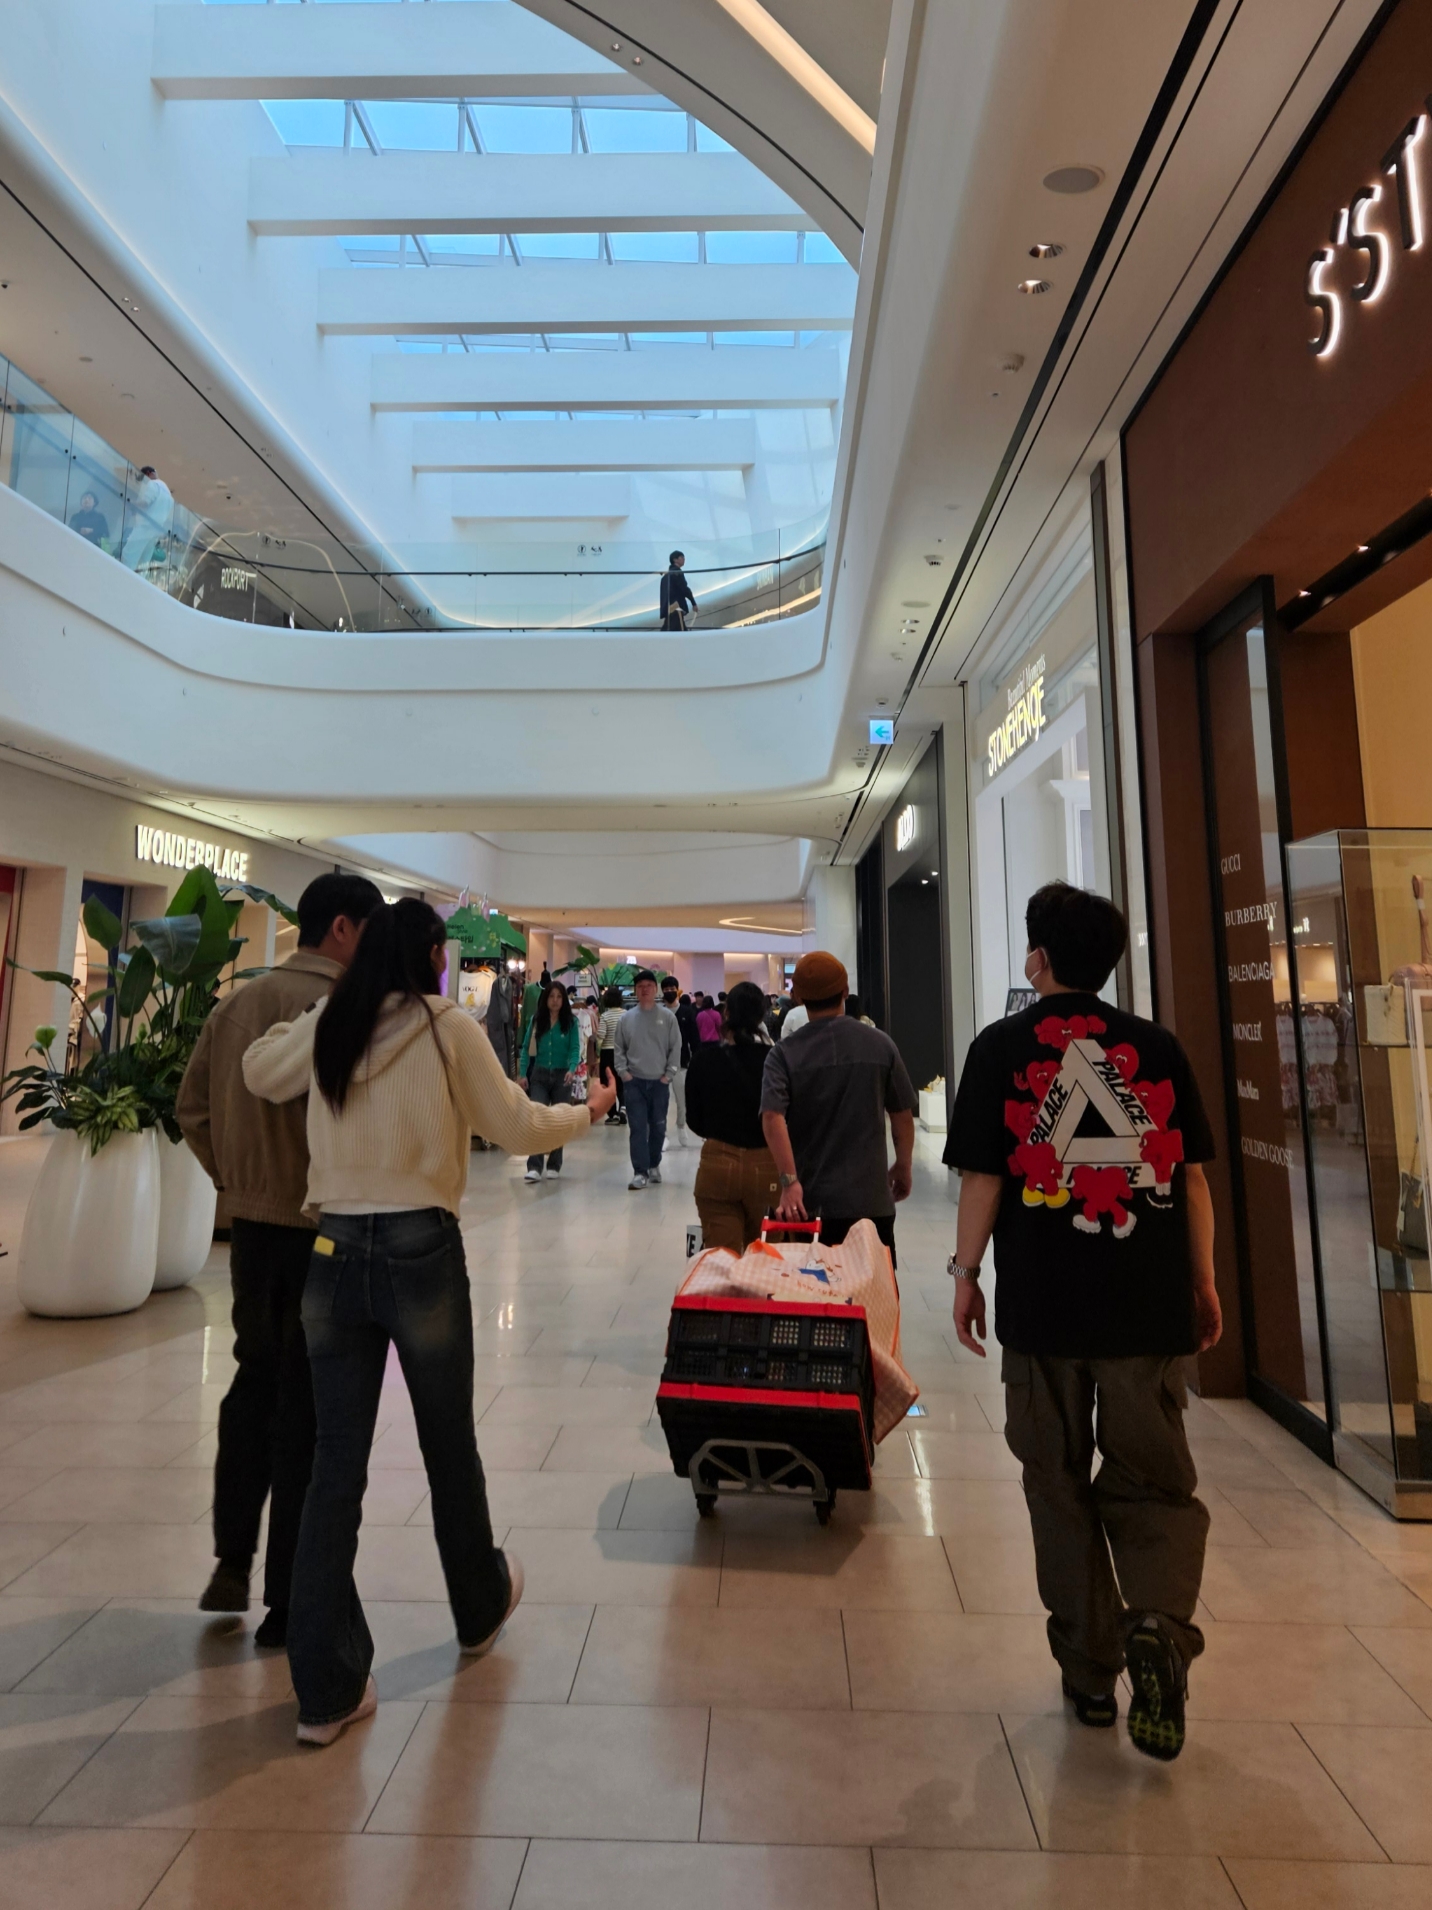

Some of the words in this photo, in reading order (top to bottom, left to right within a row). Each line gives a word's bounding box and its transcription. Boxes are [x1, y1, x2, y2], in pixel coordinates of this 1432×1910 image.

[136, 824, 249, 882] WONDERPLACE
[1220, 853, 1241, 875] GUCCI
[1225, 901, 1278, 927] BURBERRY
[1228, 961, 1276, 982] BALENCIAGA
[1232, 1021, 1263, 1041] MONCLER
[1091, 1061, 1153, 1126] PALACE
[1030, 1078, 1069, 1146] PALACE
[1241, 1136, 1268, 1160] GOLDEN
[1268, 1144, 1295, 1169] GOOSE
